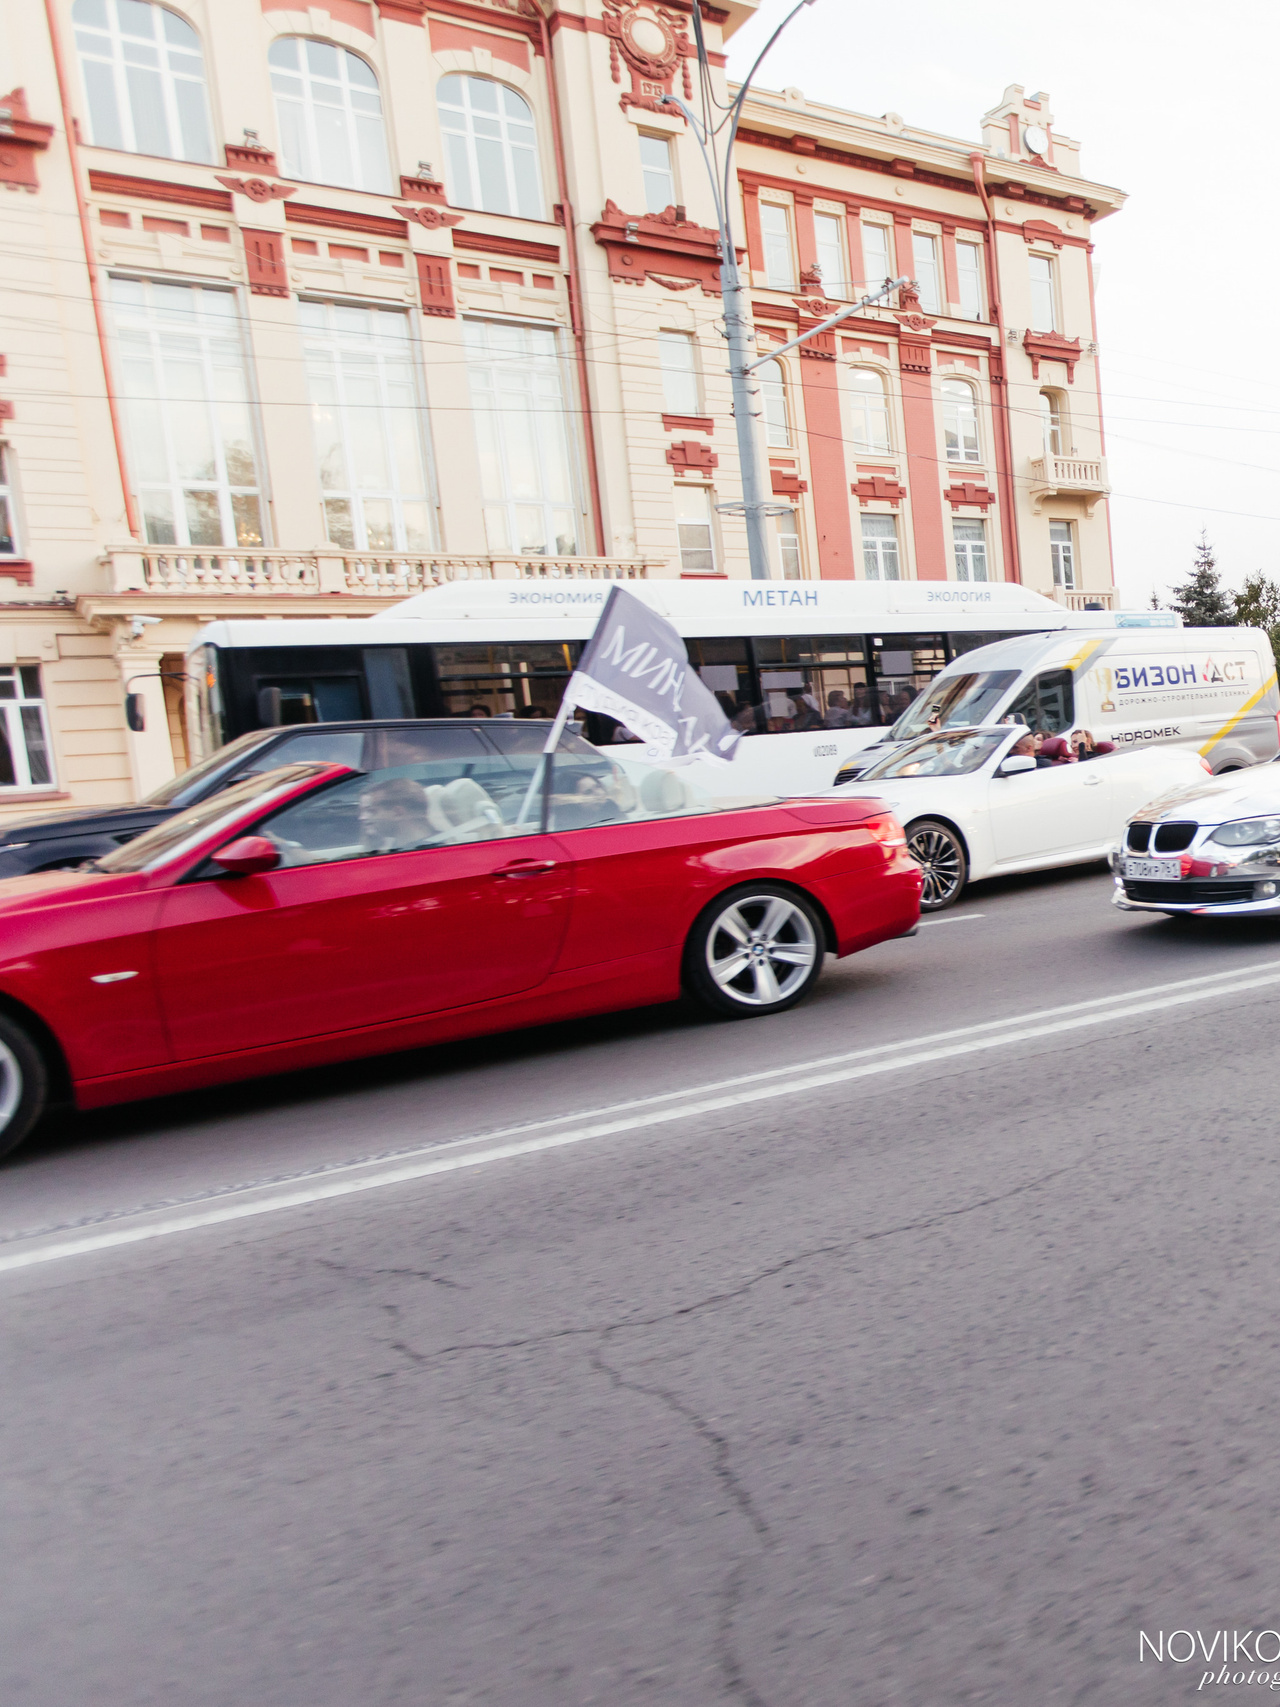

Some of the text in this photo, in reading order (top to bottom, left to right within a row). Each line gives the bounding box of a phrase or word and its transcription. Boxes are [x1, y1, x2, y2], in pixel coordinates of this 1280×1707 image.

[508, 592, 604, 604] ЭКОНОМИЯ
[743, 590, 818, 606] МЕТАН
[927, 591, 991, 602] ЭКОЛОГИЯ
[1115, 664, 1197, 689] БИЗОН
[1119, 689, 1250, 706] ДОРОЖНО-СТРОИТЕЛЬНАЯ ТЕХНИКА
